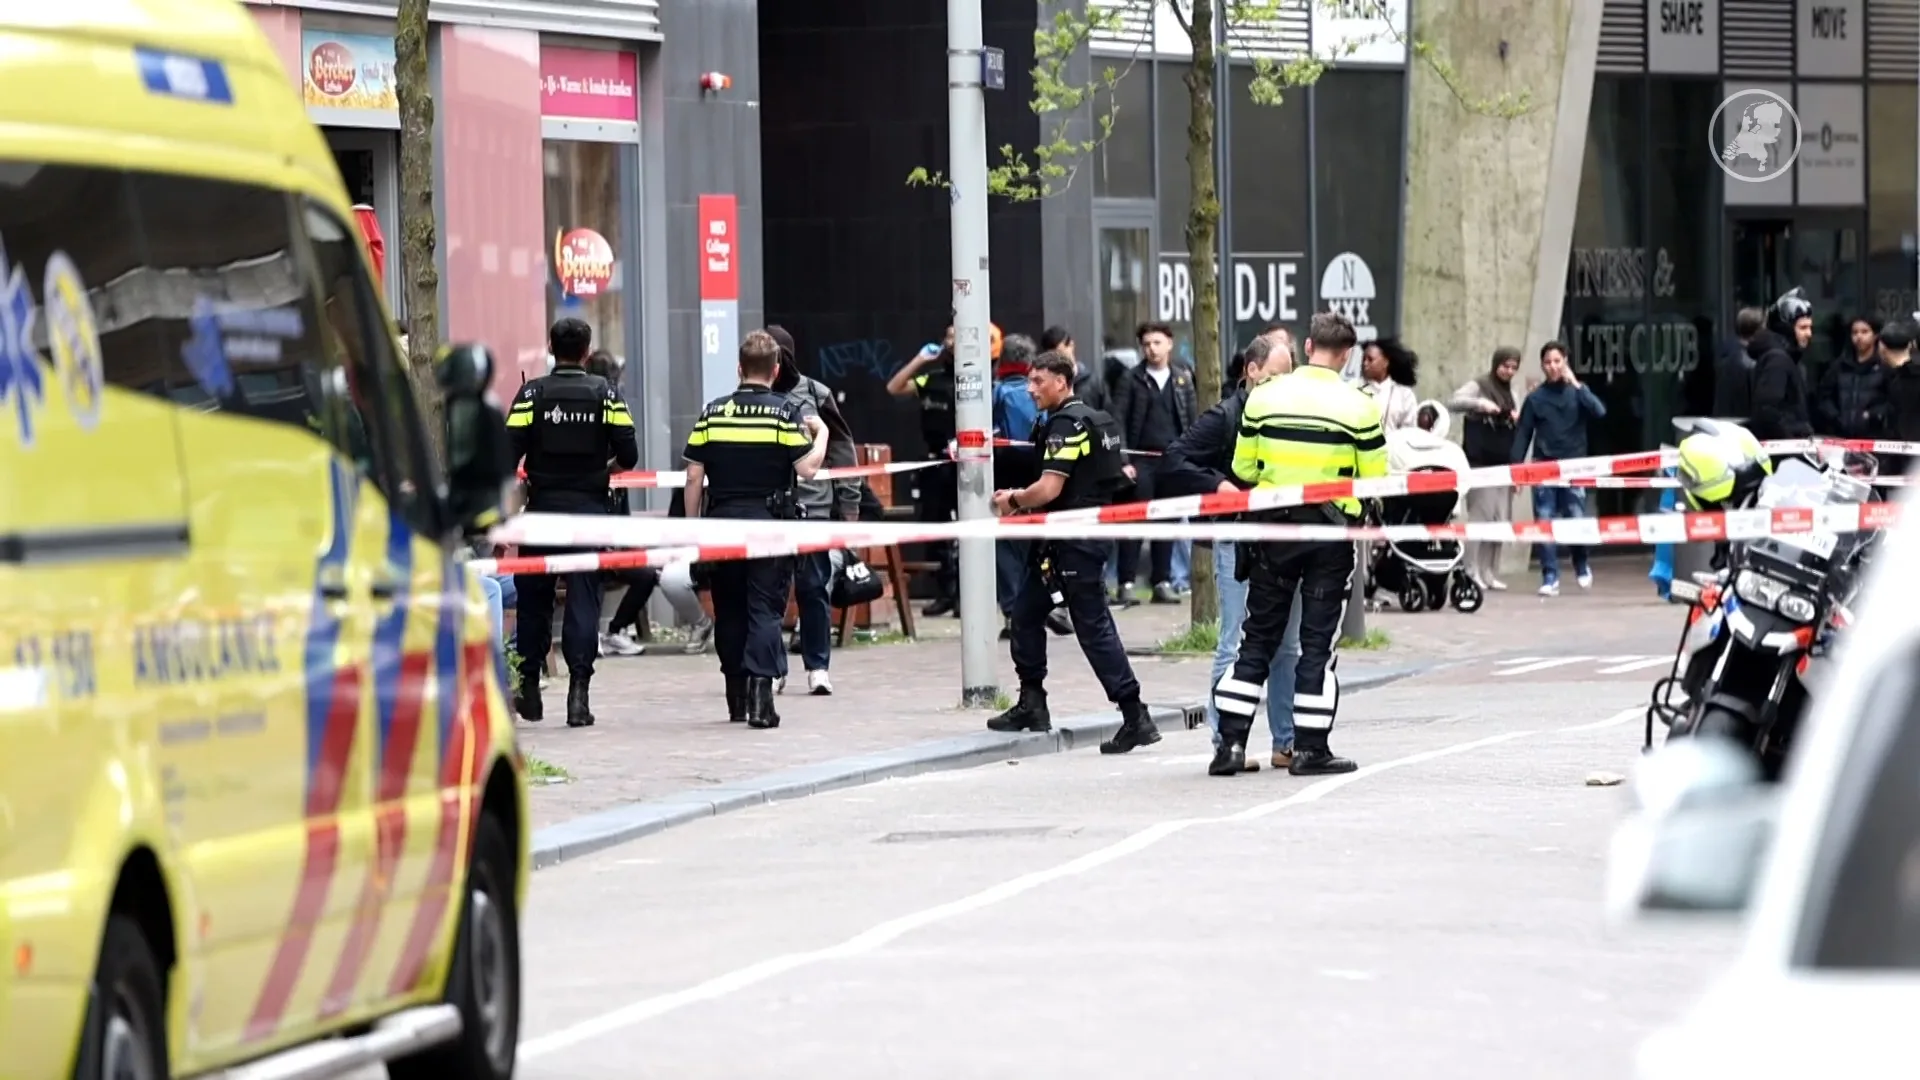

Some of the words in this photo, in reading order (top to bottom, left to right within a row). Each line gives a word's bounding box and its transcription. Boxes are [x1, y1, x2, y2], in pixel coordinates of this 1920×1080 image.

[1660, 0, 1704, 35] SHAPE
[1811, 6, 1847, 39] MOVE
[1342, 258, 1355, 292] N
[1653, 246, 1676, 298] &
[1158, 262, 1298, 322] BRDJE
[703, 323, 719, 354] 13
[1629, 322, 1700, 374] CLUB
